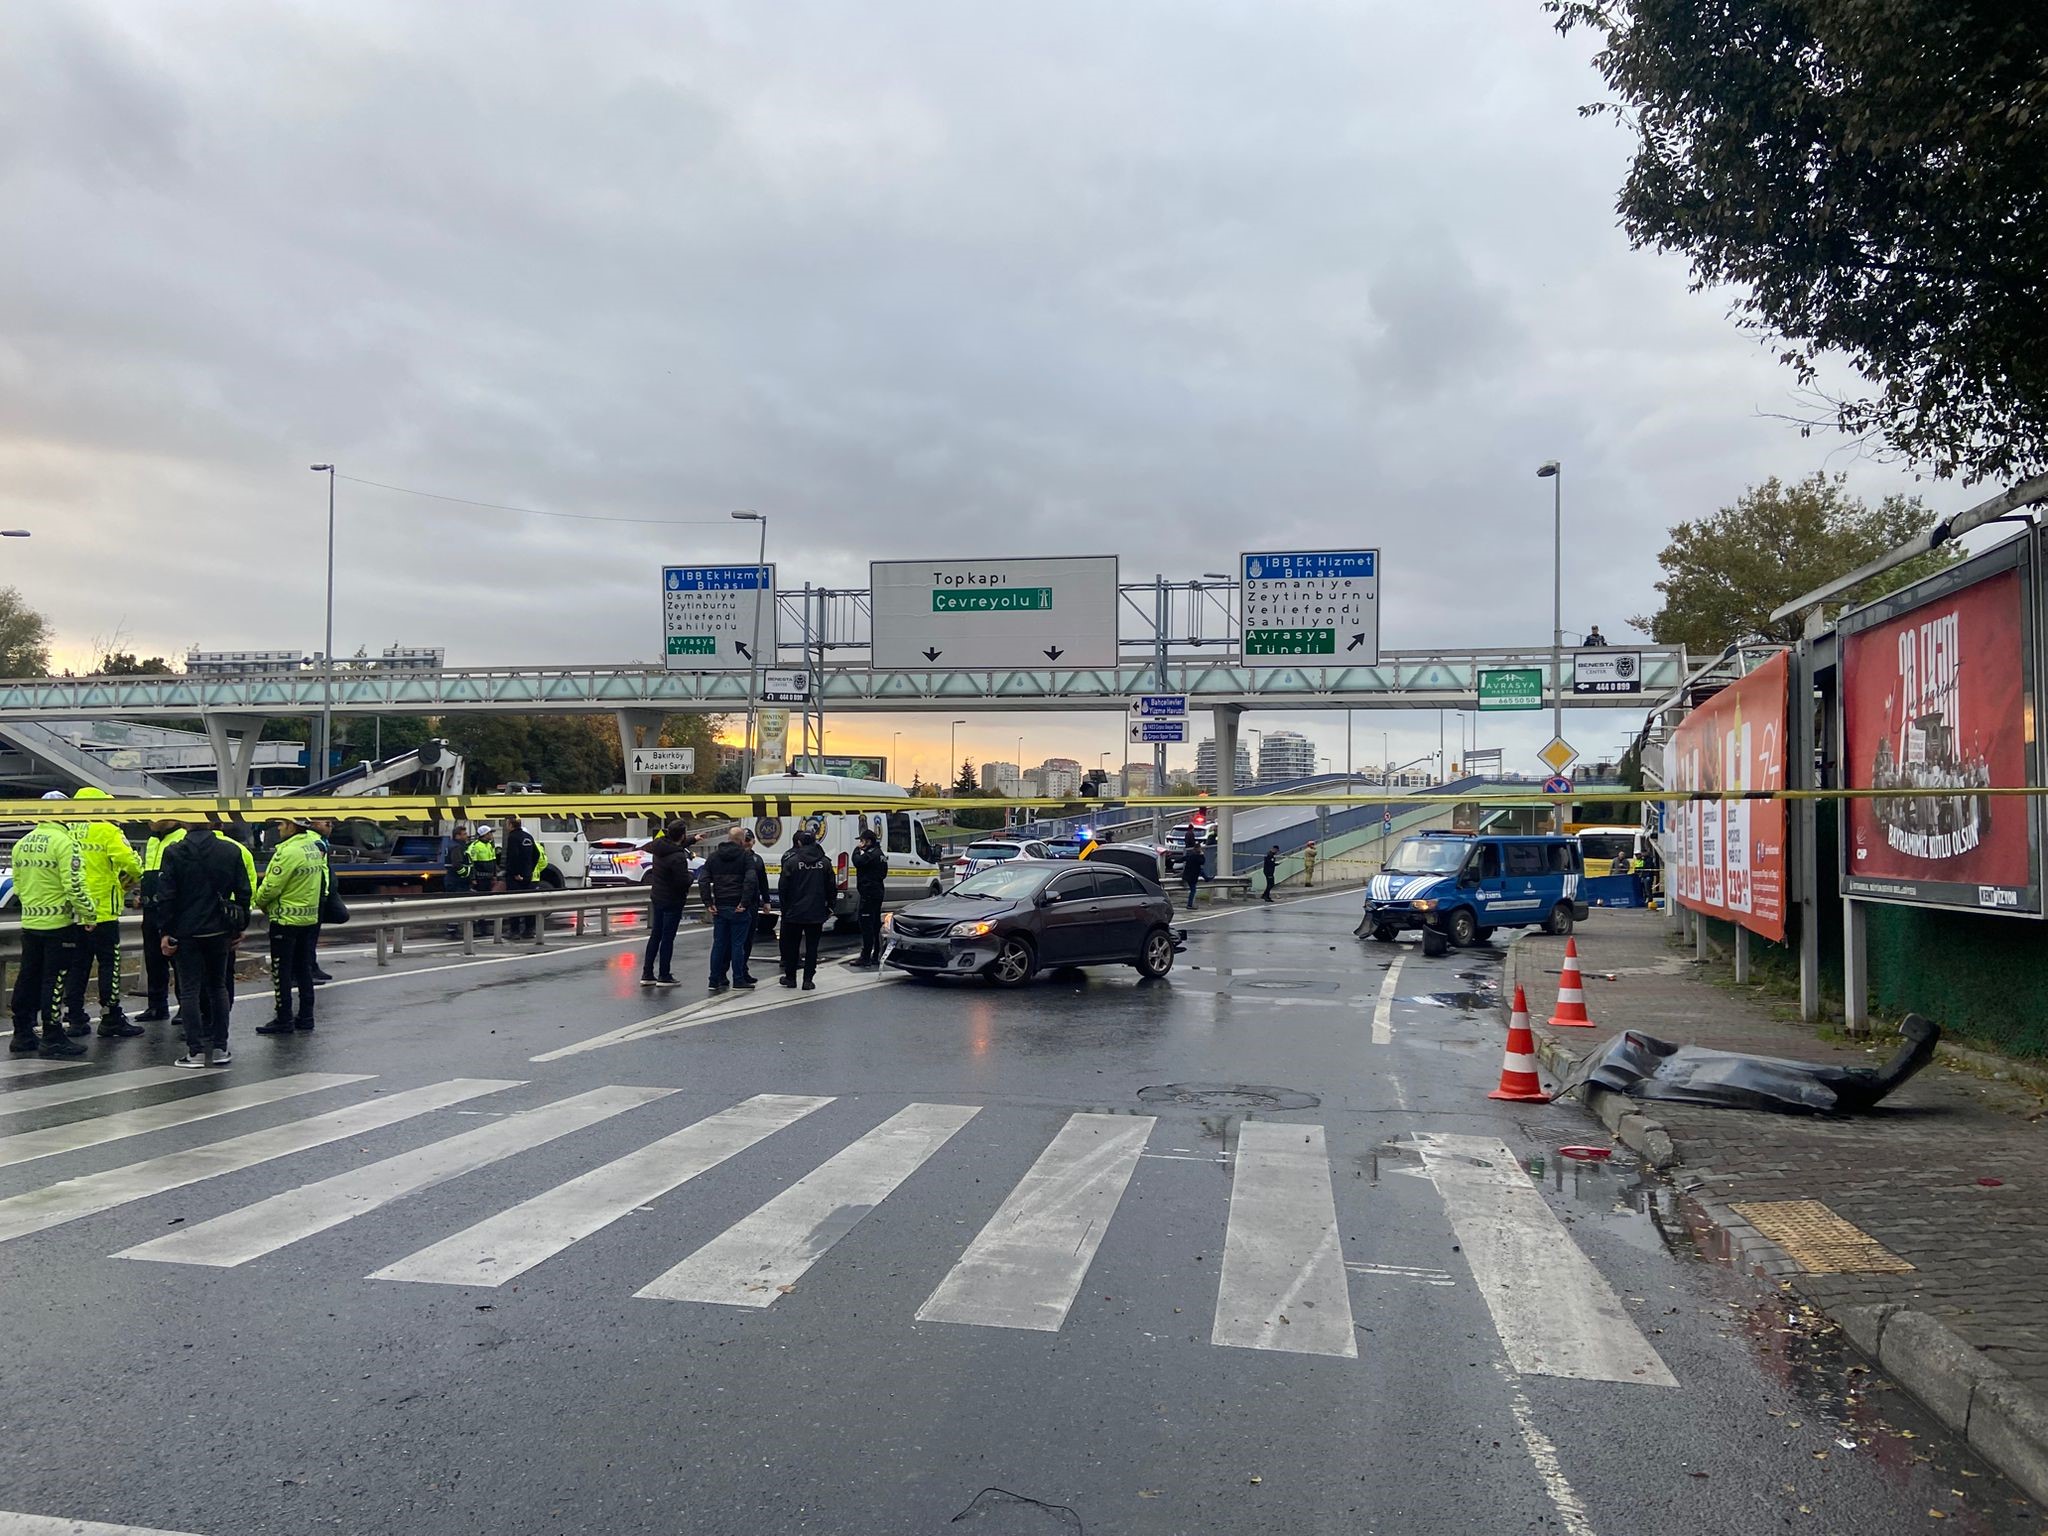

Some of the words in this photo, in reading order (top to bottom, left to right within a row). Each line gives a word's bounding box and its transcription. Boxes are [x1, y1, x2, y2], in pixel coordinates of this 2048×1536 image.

[1265, 555, 1291, 567] İBB
[1296, 557, 1313, 567] Ek
[1318, 555, 1372, 567] Hizmet
[706, 571, 720, 580] Ek
[1285, 568, 1342, 578] Binası
[933, 571, 1006, 588] Topkapı
[697, 581, 744, 590] Binası
[1247, 580, 1352, 591] Osmaniye
[667, 592, 736, 601] Osmaniye
[936, 593, 1030, 610] Çevreyolu
[1247, 590, 1375, 604] Zeytinburnu
[667, 601, 736, 611] Zeytinburnu
[1247, 604, 1360, 615] Veliefendi
[667, 613, 737, 621] Veliefendi
[1247, 616, 1360, 628] Sahilyolu
[668, 622, 738, 633] Sahilyolu
[1247, 630, 1328, 641] Avrasya
[669, 637, 715, 647] Avrasya
[674, 646, 711, 655] Tüneli
[1254, 643, 1320, 655] Tüneli
[1486, 682, 1536, 690] AVRASYA
[1595, 682, 1610, 691] 444
[652, 751, 685, 761] Bakırköy
[669, 762, 693, 771] Sarayı
[1887, 823, 1929, 858] BAYRAMIMIZ
[1929, 832, 1952, 860] KUTLU
[1952, 822, 1980, 856] OLSUN
